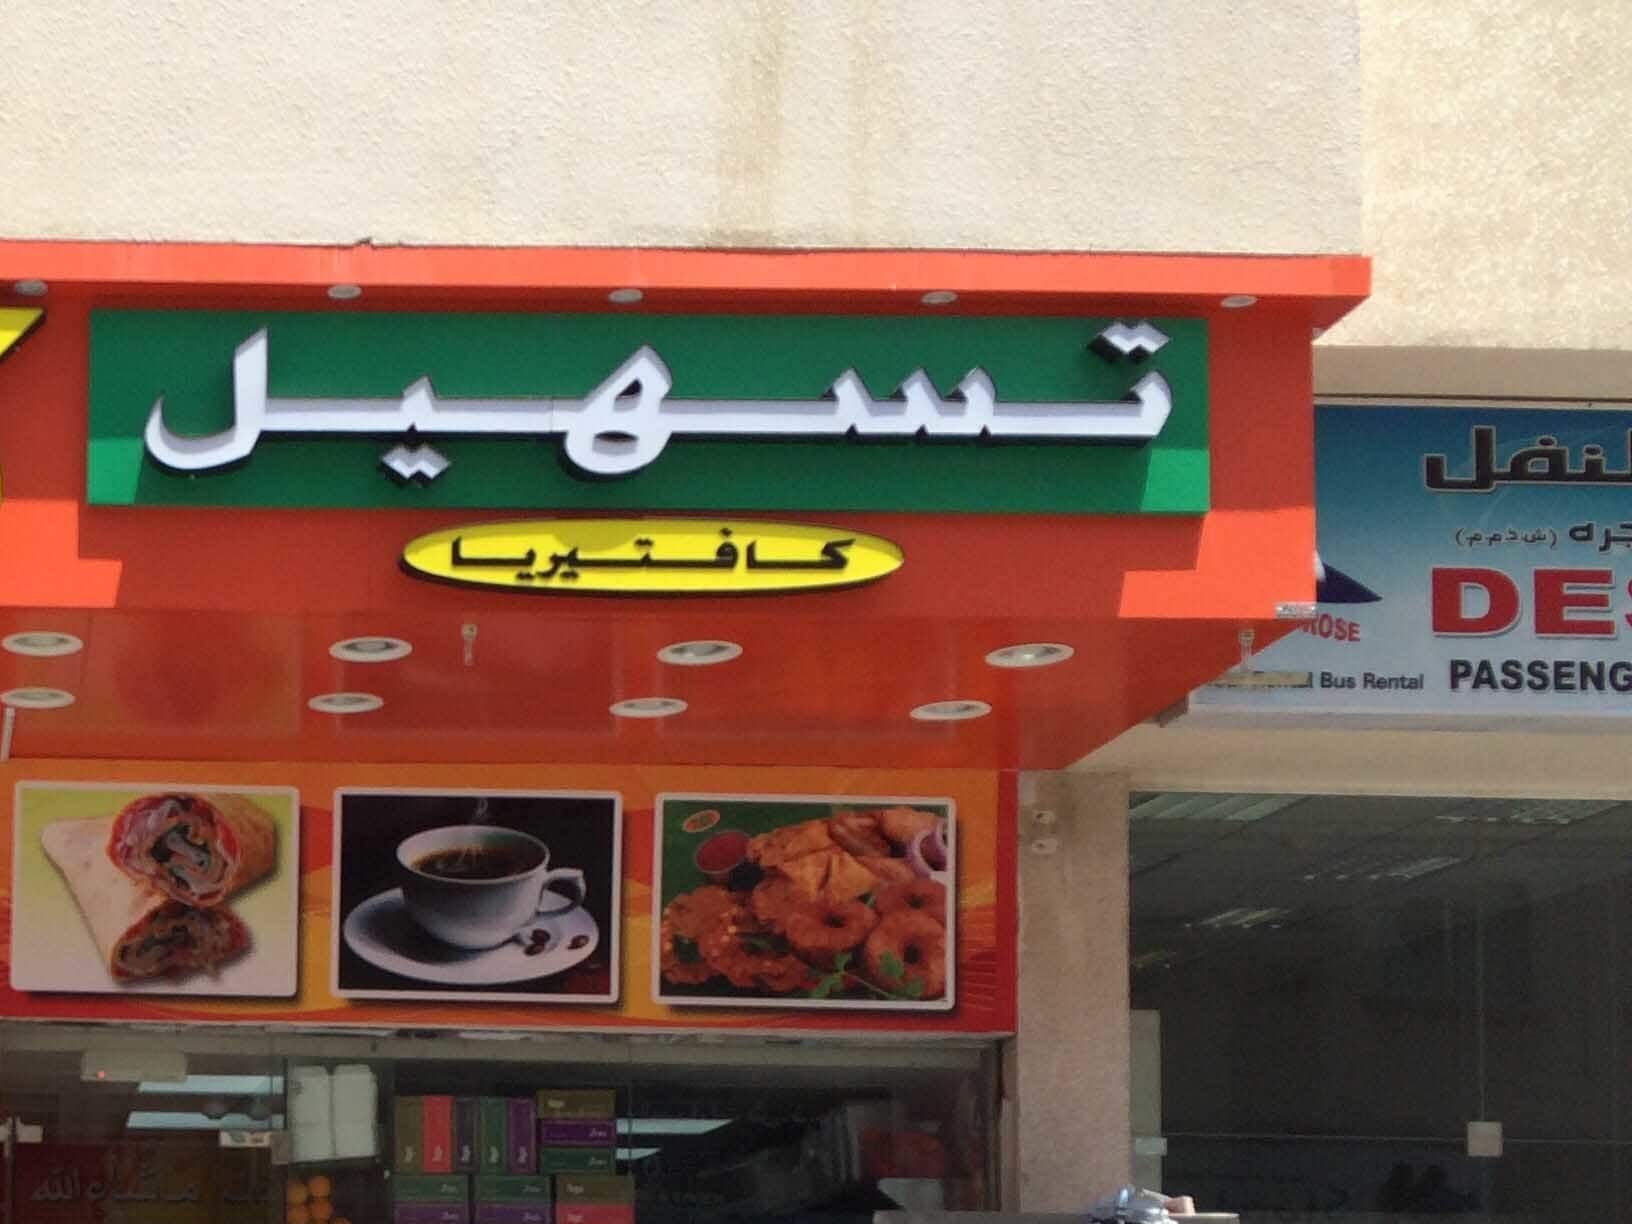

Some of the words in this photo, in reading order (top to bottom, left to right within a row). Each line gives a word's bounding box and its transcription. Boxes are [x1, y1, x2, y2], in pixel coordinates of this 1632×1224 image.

[144, 319, 1171, 482] تسهيل
[451, 531, 855, 580] كافتيريا
[1430, 565, 1632, 638] DE
[1319, 671, 1357, 690] Bus
[1362, 671, 1425, 691] Rental
[1449, 659, 1632, 692] PASSENG
